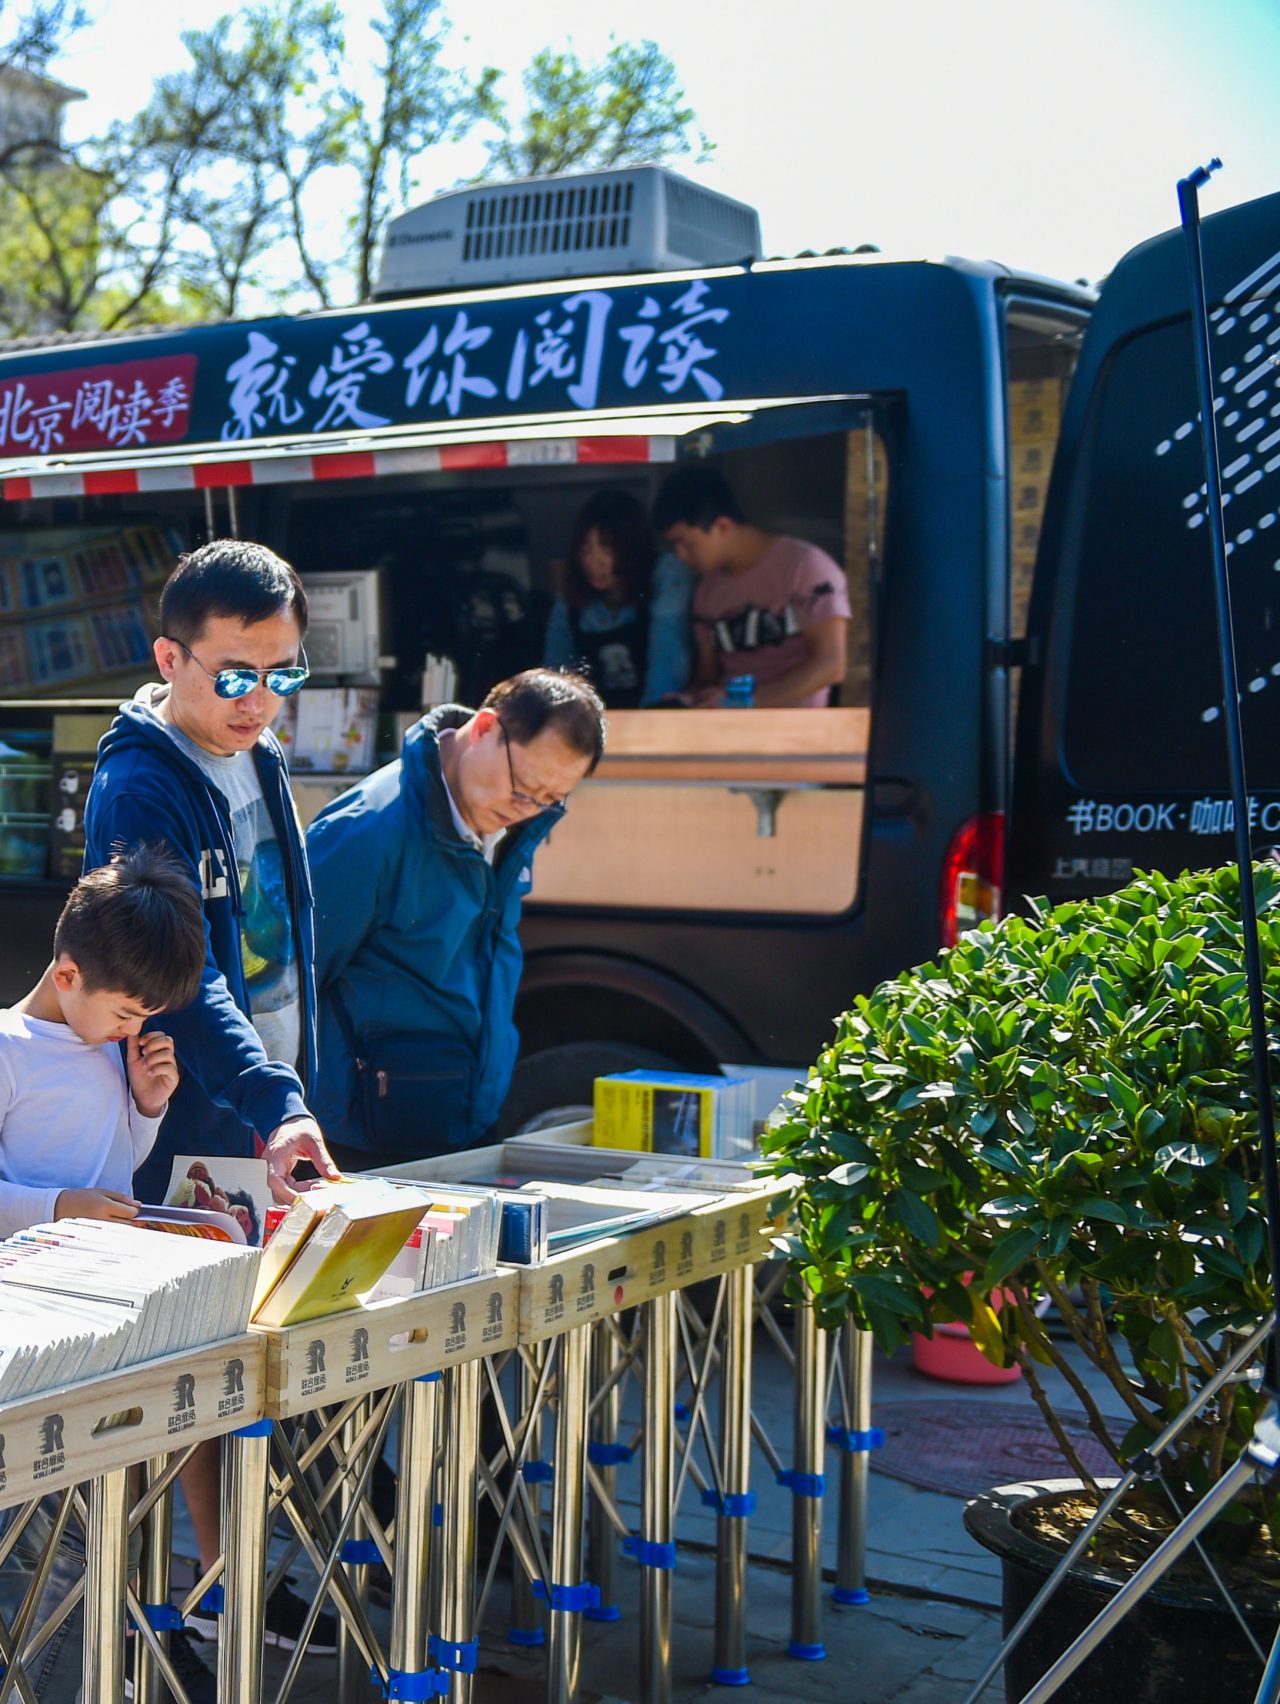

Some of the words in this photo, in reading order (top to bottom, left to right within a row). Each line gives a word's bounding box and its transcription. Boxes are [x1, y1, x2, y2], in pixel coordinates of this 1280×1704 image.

[222, 279, 730, 441] 就爱你阅读
[547, 1274, 563, 1305] R
[579, 1264, 595, 1293] R
[448, 1302, 465, 1334] R
[485, 1292, 503, 1324] R
[303, 1340, 326, 1375] R
[347, 1328, 369, 1362] R
[170, 1373, 195, 1412] R
[221, 1359, 244, 1396] R
[36, 1414, 64, 1455] R
